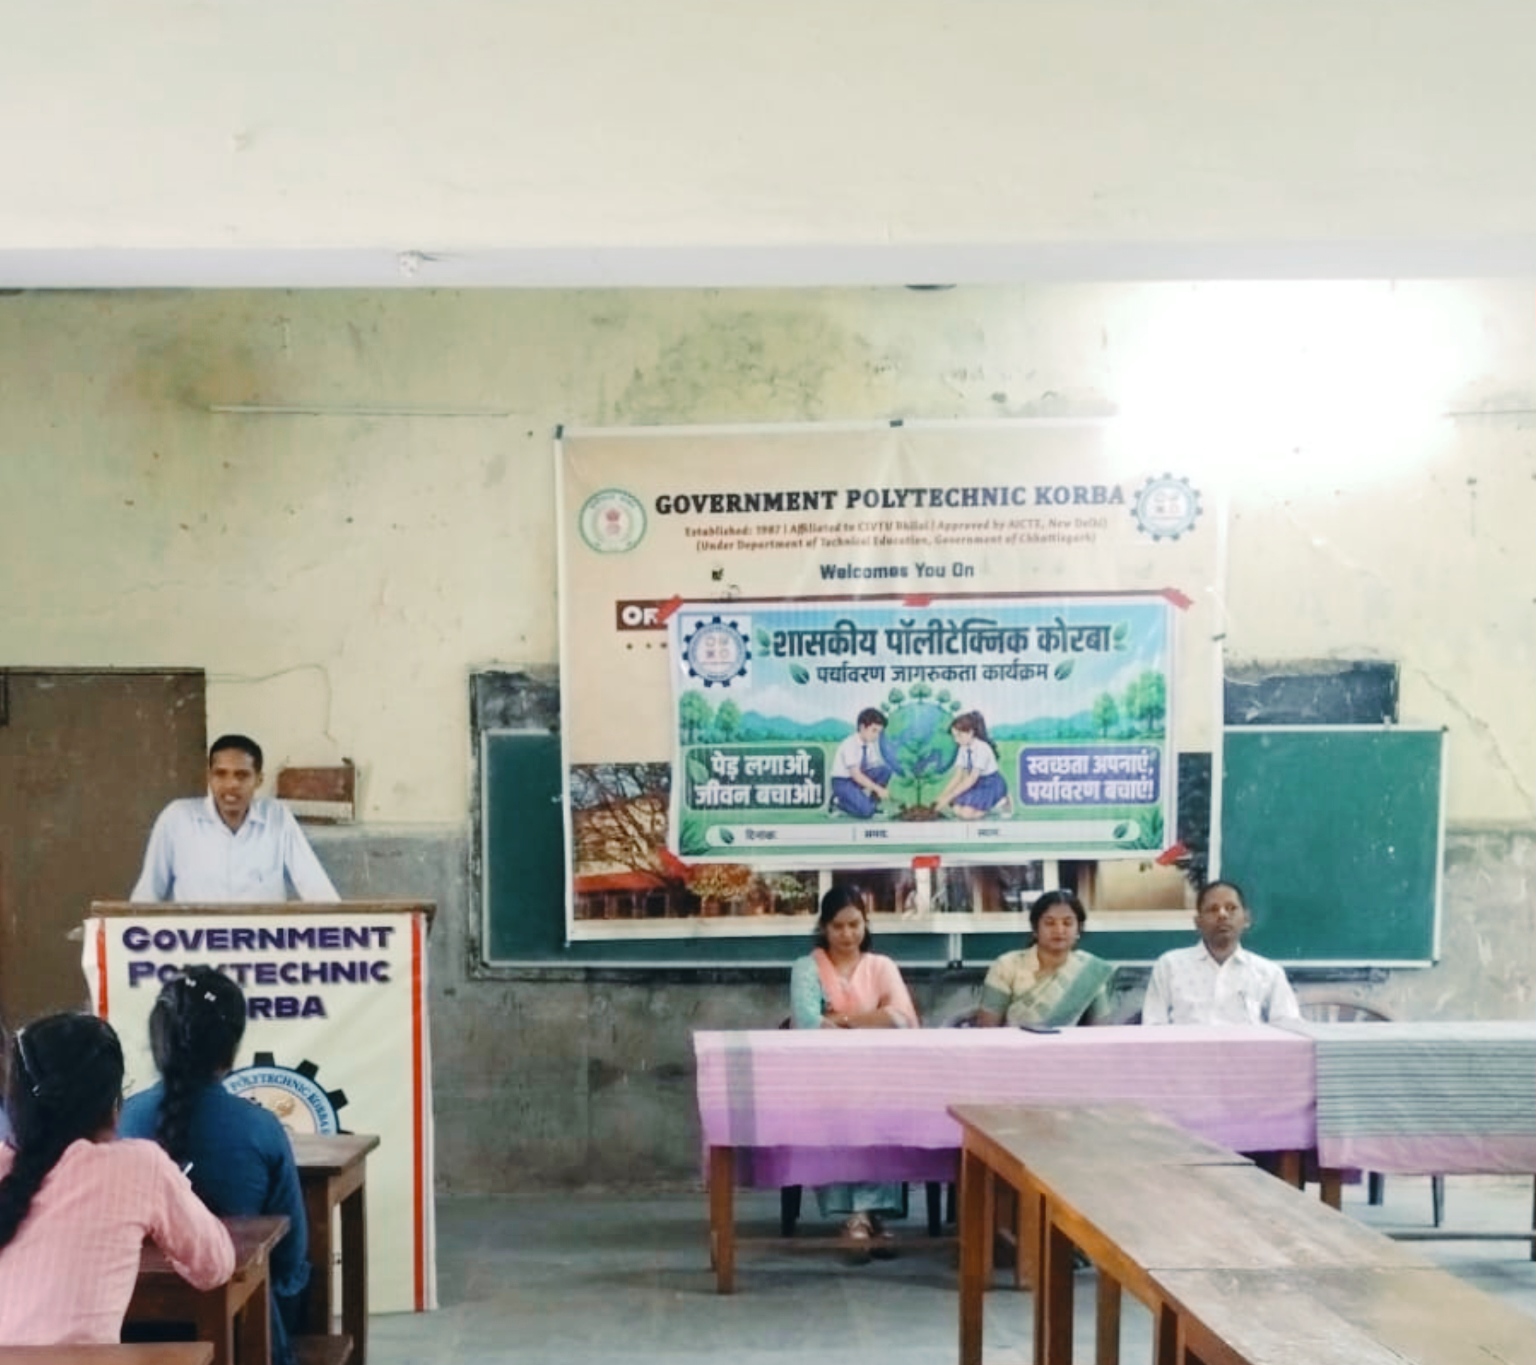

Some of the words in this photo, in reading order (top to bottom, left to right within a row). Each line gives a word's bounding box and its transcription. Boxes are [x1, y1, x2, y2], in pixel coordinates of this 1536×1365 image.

[655, 490, 838, 515] GOVERNMENT
[846, 486, 1026, 509] POLYTECHNIC
[1034, 484, 1125, 505] KORBA
[820, 562, 908, 580] Welcomes
[915, 562, 946, 579] You
[952, 562, 975, 578] On
[772, 619, 877, 658] शासकीय
[886, 617, 1030, 657] पॉलीटेक्निक
[1036, 617, 1112, 655] कोरबा
[817, 659, 886, 684] पर्यावरण
[982, 658, 1049, 683] कार्यक्रम
[711, 749, 739, 779] पेड़
[745, 748, 816, 779] लगाओ,
[1028, 752, 1088, 776] स्वच्छता
[695, 778, 750, 806] जीवन
[755, 778, 822, 805] बचाओ!
[1028, 771, 1099, 801] पर्यावरण
[122, 926, 394, 951] GOVERNMENT
[128, 961, 391, 987] POTECHNIC
[247, 996, 328, 1019] RBA
